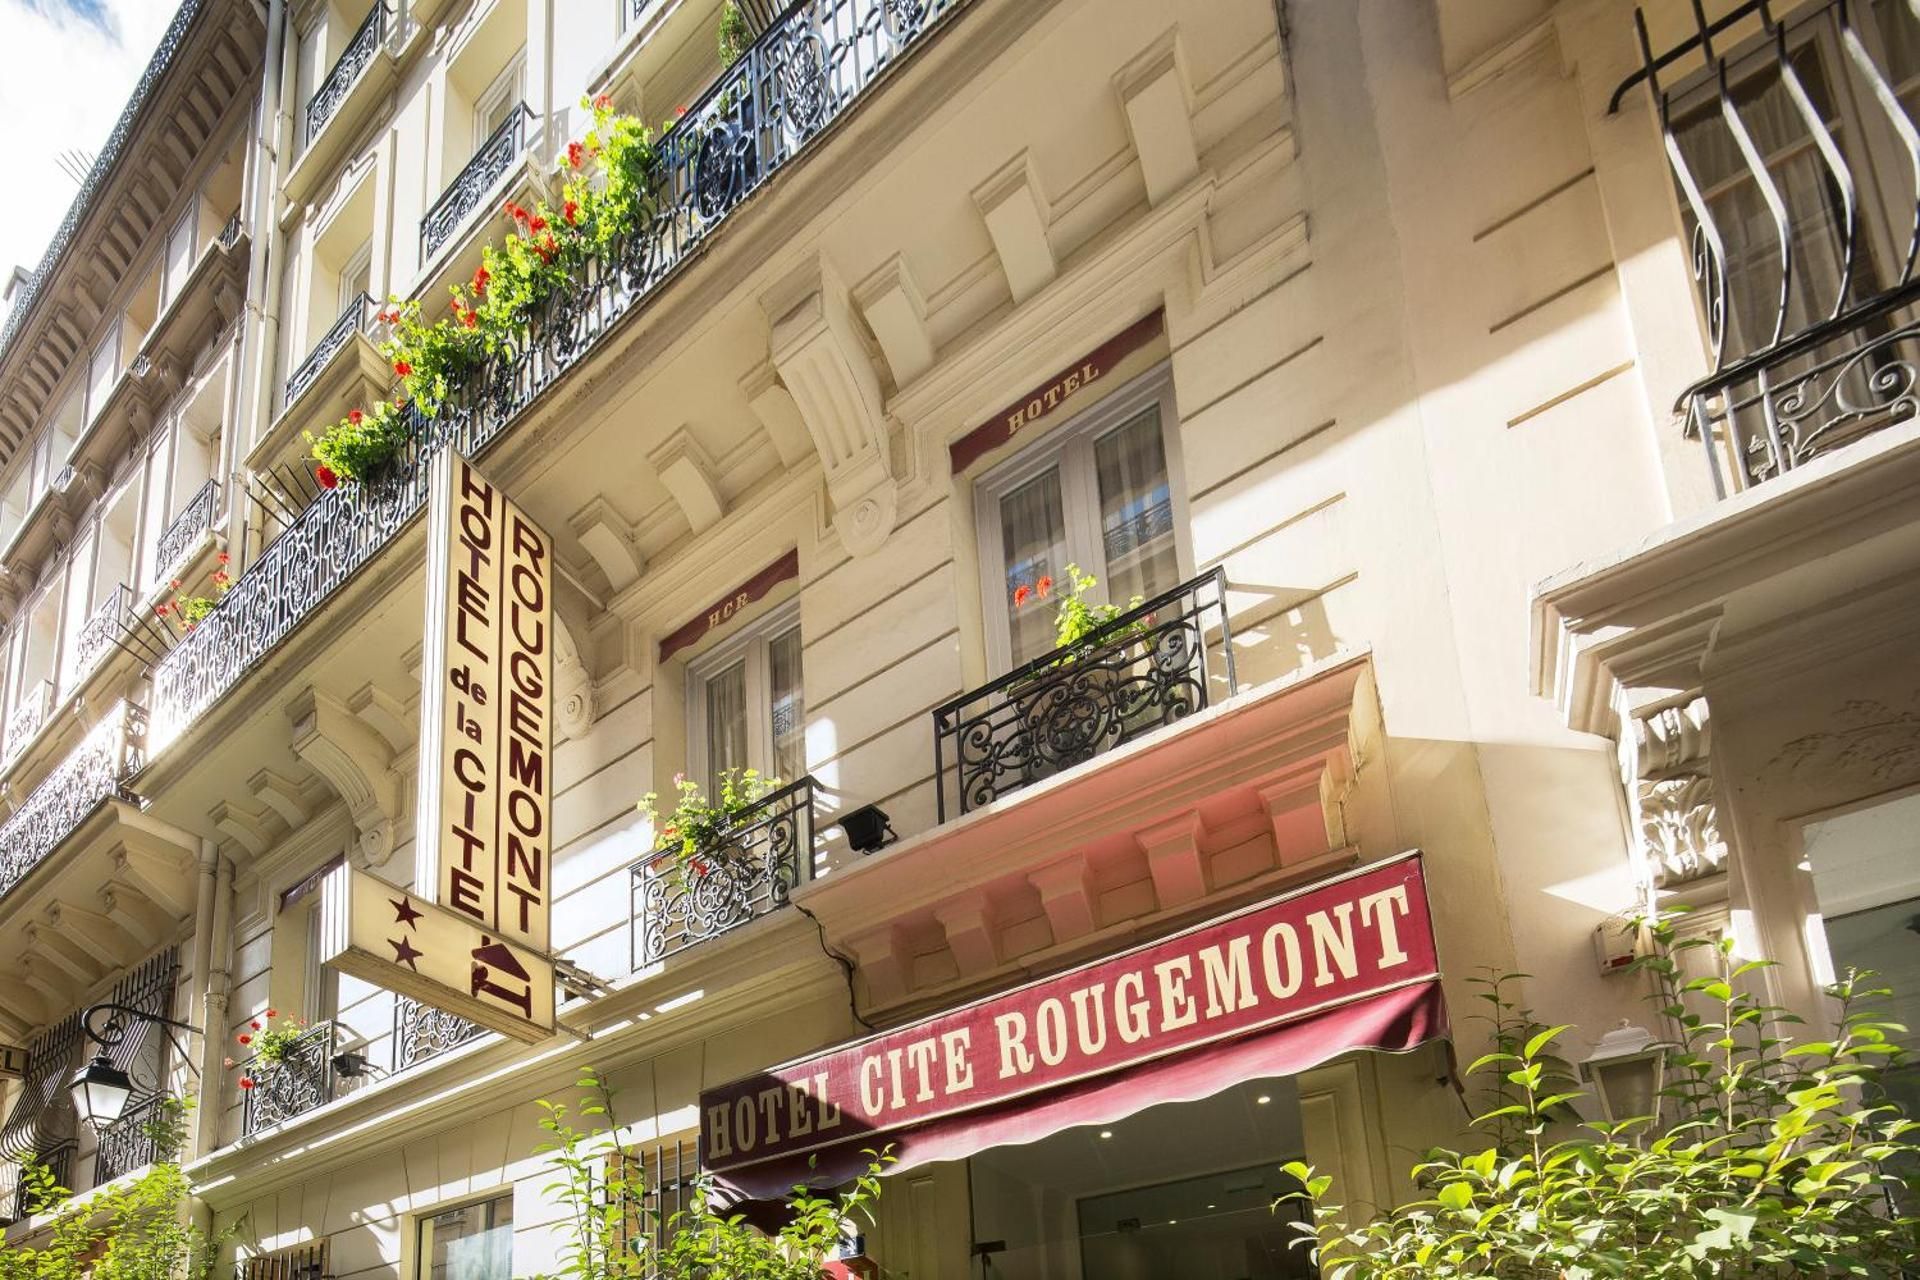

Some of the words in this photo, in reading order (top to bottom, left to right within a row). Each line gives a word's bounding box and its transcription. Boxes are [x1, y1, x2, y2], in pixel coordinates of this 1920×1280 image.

[1007, 362, 1099, 435] HOTEL
[456, 461, 493, 664] HOTEL
[708, 592, 749, 629] HCR
[450, 664, 487, 706] de
[456, 700, 482, 745] la
[507, 517, 546, 935] ROUGEMONT
[450, 747, 486, 920] CITE
[707, 1071, 841, 1159] HOTEL
[860, 1026, 975, 1117] CITE
[995, 884, 1410, 1079] ROUGEMONT
